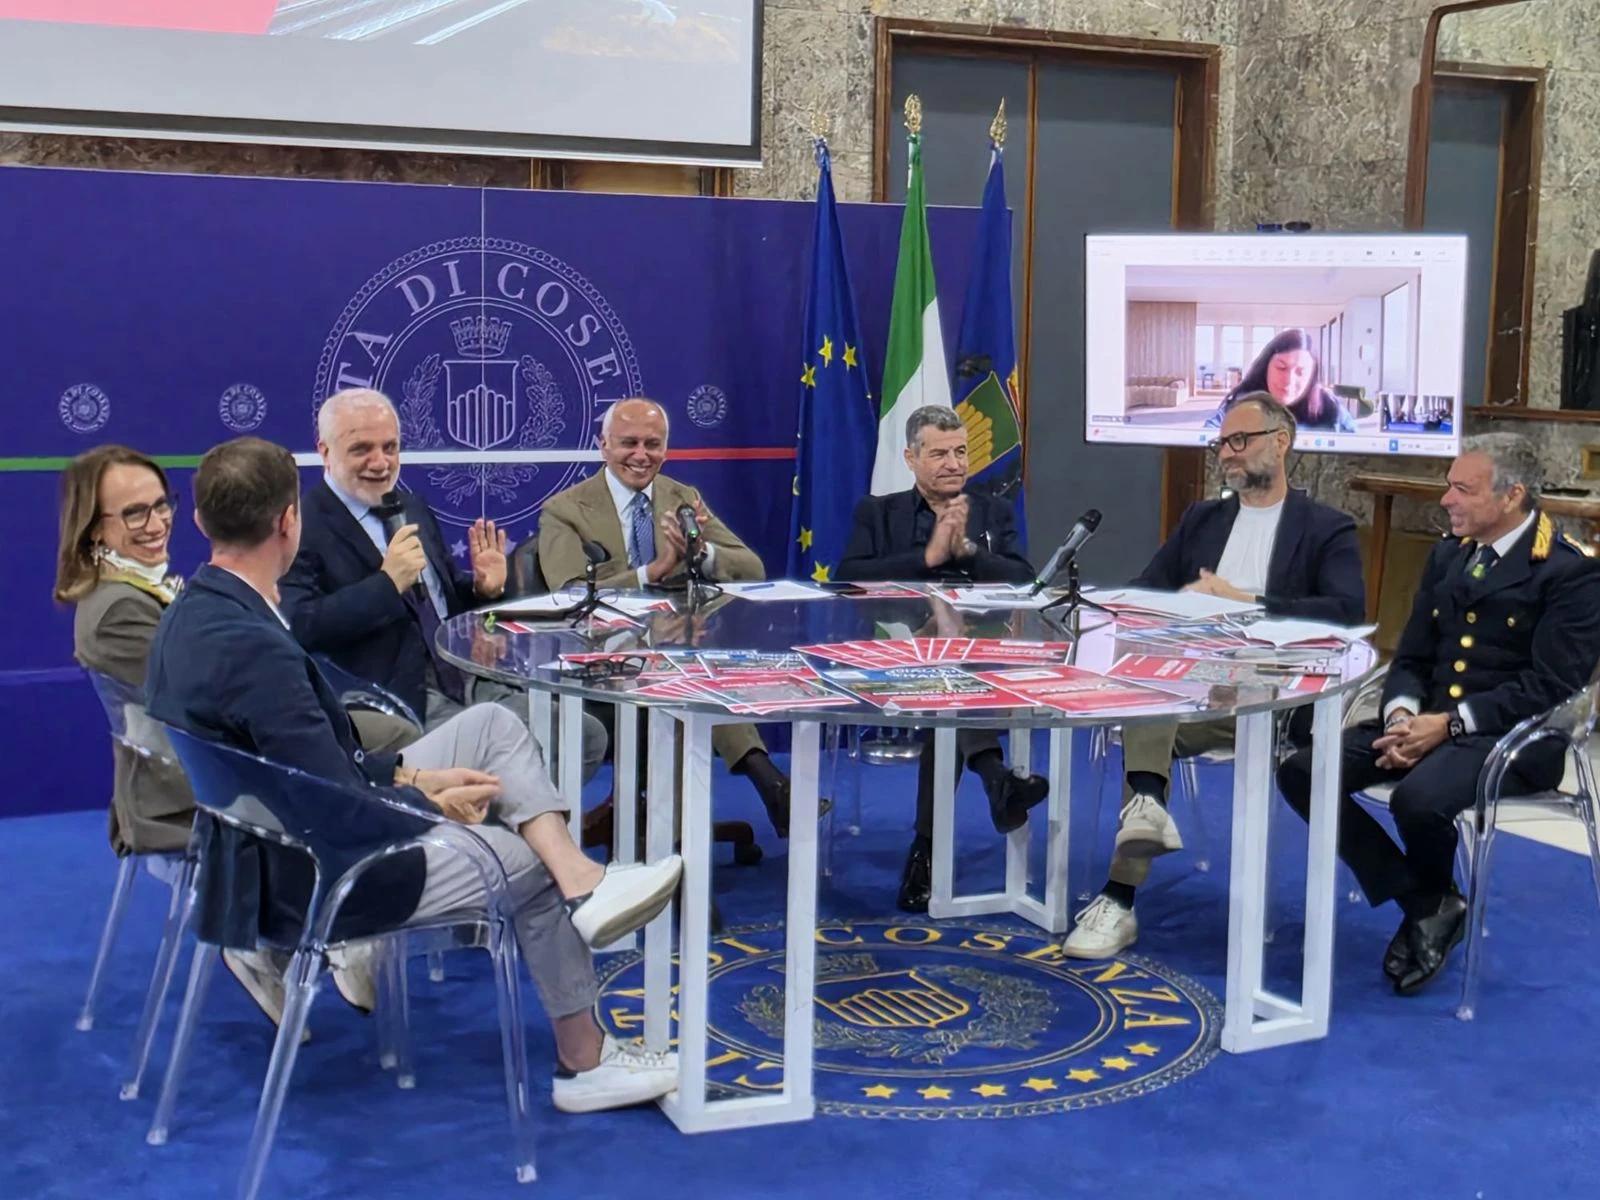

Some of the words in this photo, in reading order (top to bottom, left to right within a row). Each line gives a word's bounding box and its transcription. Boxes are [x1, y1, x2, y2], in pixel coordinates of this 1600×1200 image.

[395, 259, 467, 318] DI
[497, 260, 626, 426] COSE
[814, 926, 1192, 1030] COSENZA
